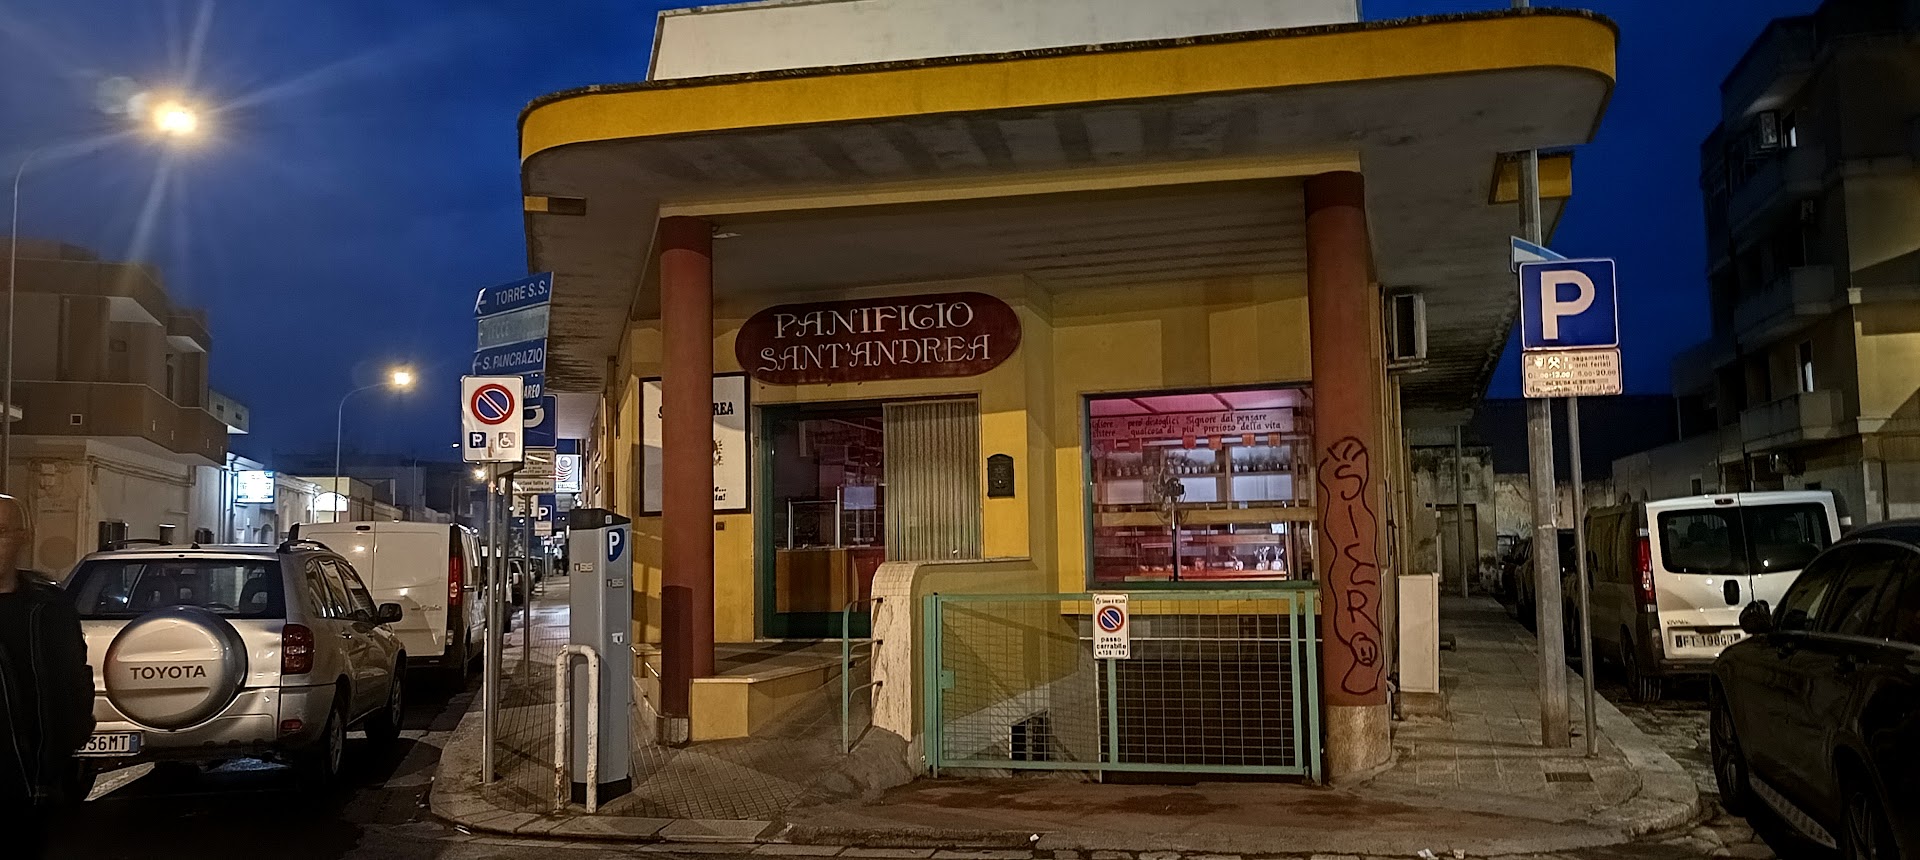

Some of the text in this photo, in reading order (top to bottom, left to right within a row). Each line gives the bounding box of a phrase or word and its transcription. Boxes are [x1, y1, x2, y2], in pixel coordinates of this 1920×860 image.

[495, 285, 526, 305] TORRE
[1541, 270, 1595, 340] P
[774, 301, 974, 339] PANIFICIO
[757, 334, 991, 372] SANT'ANDREA
[1130, 427, 1164, 437] qualcosa
[1167, 425, 1175, 434] di
[1203, 425, 1236, 434] prezioso
[1240, 421, 1262, 430] della
[1265, 421, 1281, 429] vita
[1186, 415, 1216, 426] Signore
[1220, 413, 1234, 422] dal
[1236, 414, 1267, 424] pensare
[609, 531, 620, 556] P
[129, 665, 207, 680] TOYOTA
[81, 735, 128, 750] 36MT
